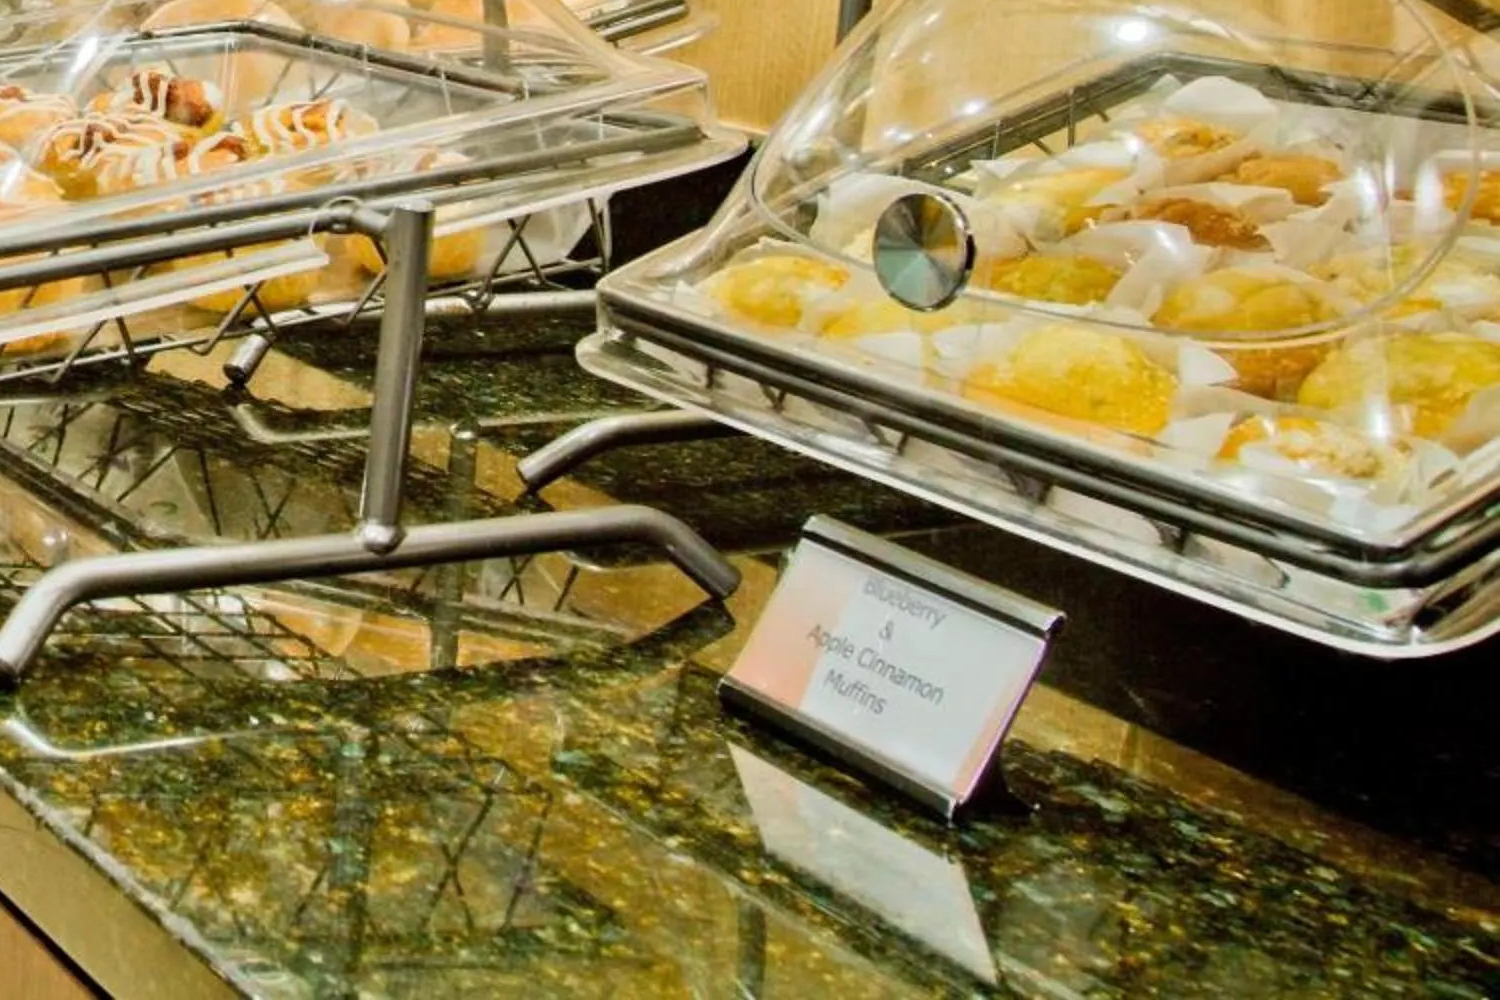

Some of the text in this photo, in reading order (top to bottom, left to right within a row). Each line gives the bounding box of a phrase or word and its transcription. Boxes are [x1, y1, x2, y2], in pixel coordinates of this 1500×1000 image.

[863, 577, 947, 629] Blueberry
[878, 619, 895, 642] &
[805, 624, 944, 706] Apple Cinnamon
[824, 668, 888, 716] Muffins
